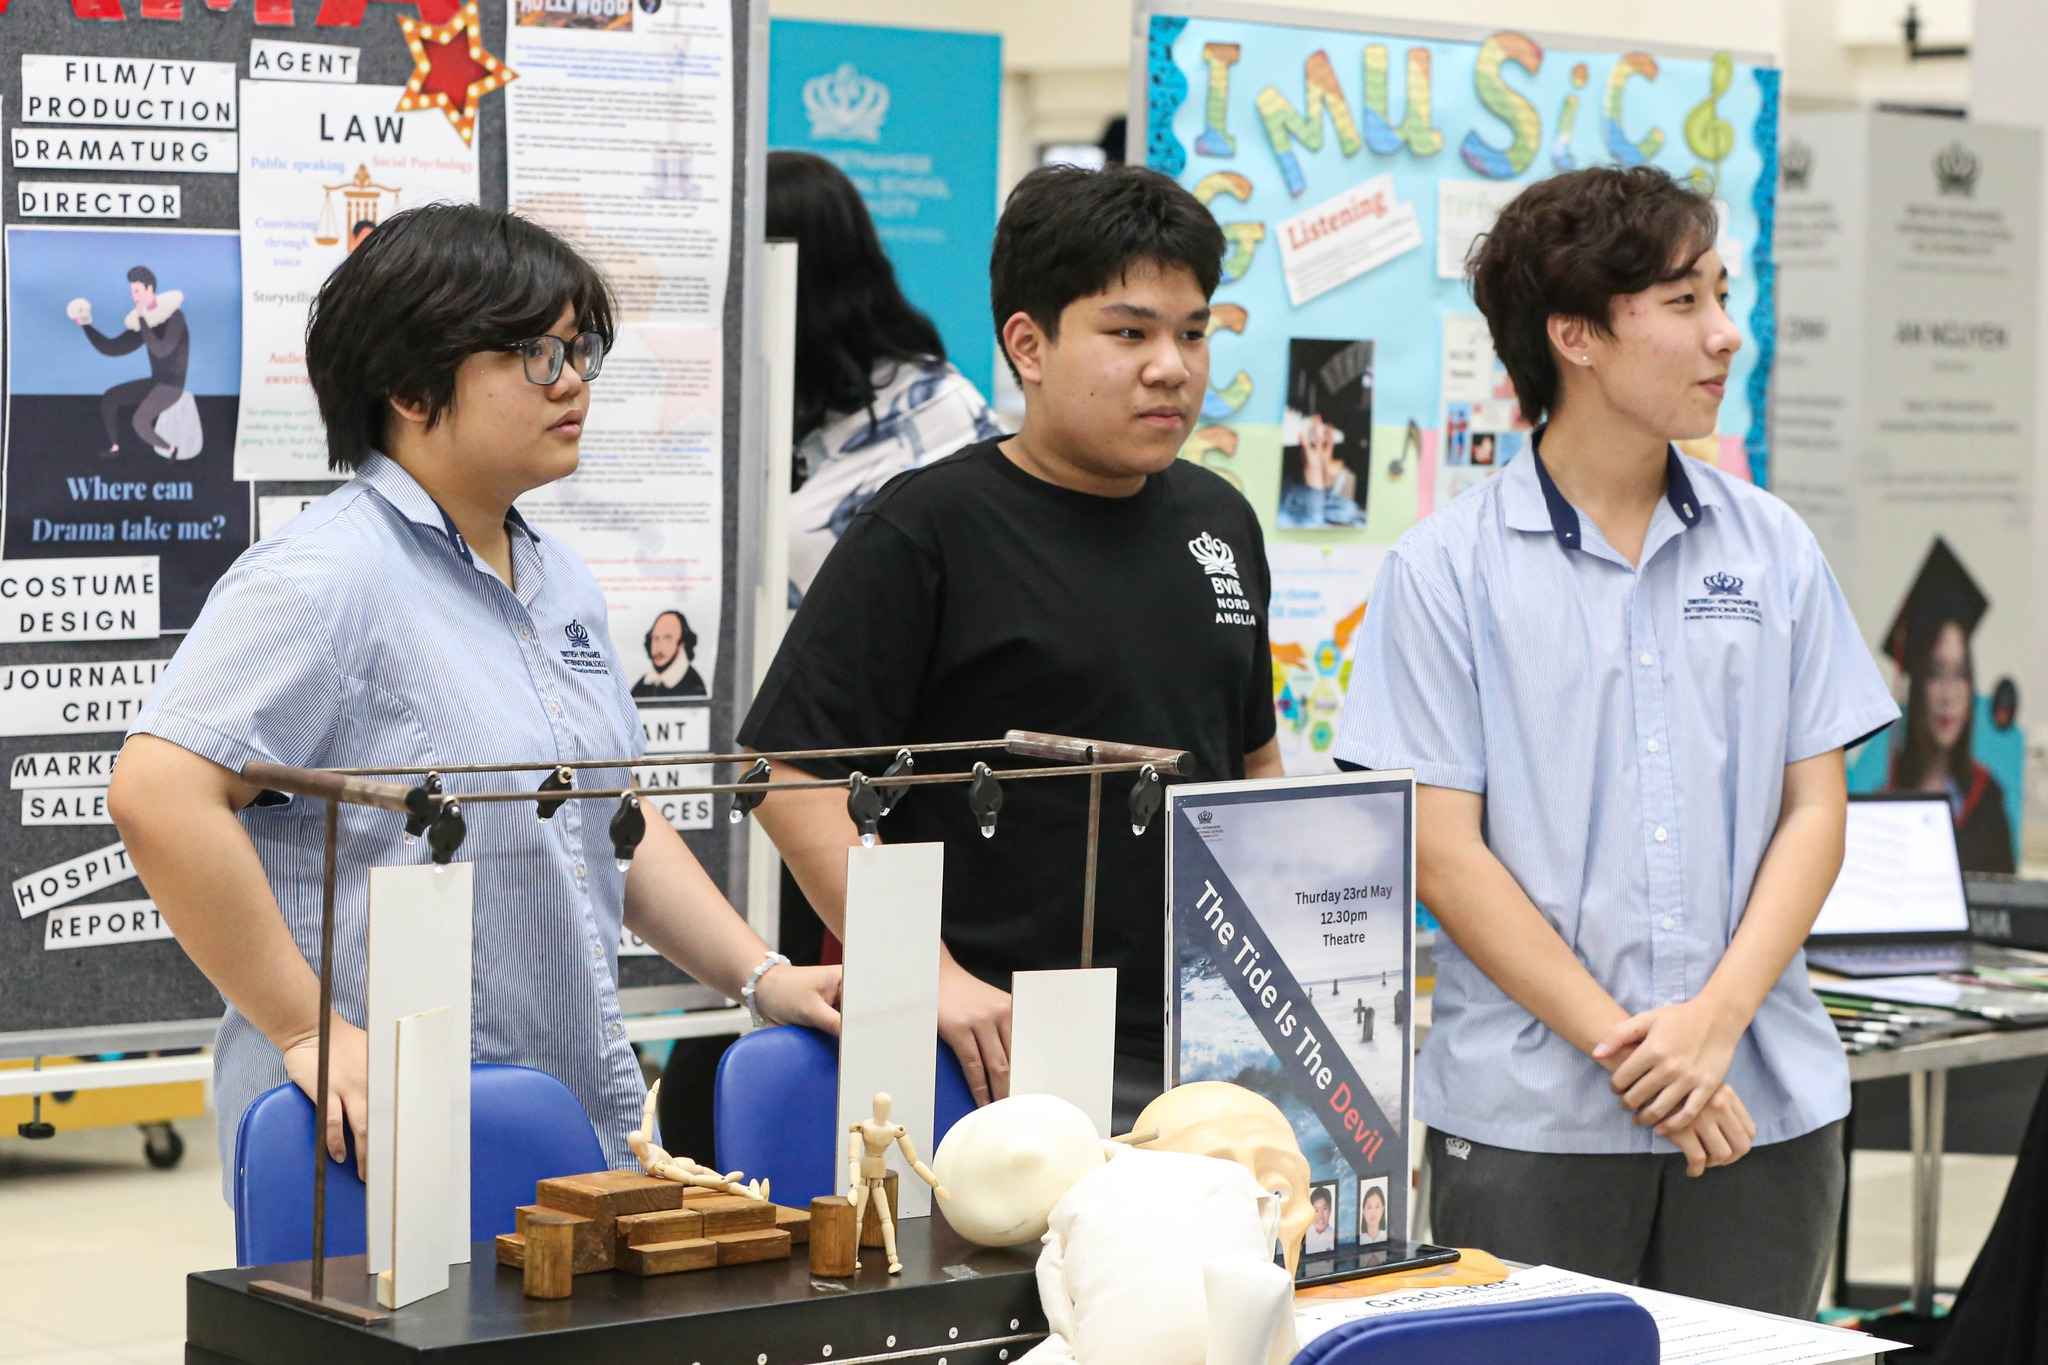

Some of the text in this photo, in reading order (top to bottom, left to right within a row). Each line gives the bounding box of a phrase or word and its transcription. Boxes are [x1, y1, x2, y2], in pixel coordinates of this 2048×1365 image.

[254, 51, 353, 75] AGENT
[66, 62, 197, 90] FILM/TV
[29, 96, 232, 122] PRODUCTION
[320, 113, 404, 143] LAW
[15, 139, 209, 162] DRAMATURG
[22, 192, 176, 214] DIRECTOR
[67, 476, 193, 500] Where can
[32, 515, 226, 541] Drama take me?
[1, 574, 154, 598] COSTUME
[1217, 598, 1250, 610] NORD
[20, 610, 136, 633] DESIGN
[1215, 612, 1256, 626] ANGLIA
[1296, 884, 1393, 905] Thurday 23rd May
[1321, 910, 1368, 928] 12.30pm
[1323, 932, 1366, 947] Theatre
[1195, 879, 1235, 946] The
[1233, 935, 1277, 1009] Tide
[1273, 1000, 1297, 1037] Is
[1295, 1026, 1333, 1090] The
[1329, 1081, 1384, 1165] Devil
[1365, 1280, 1521, 1310] Graduates
